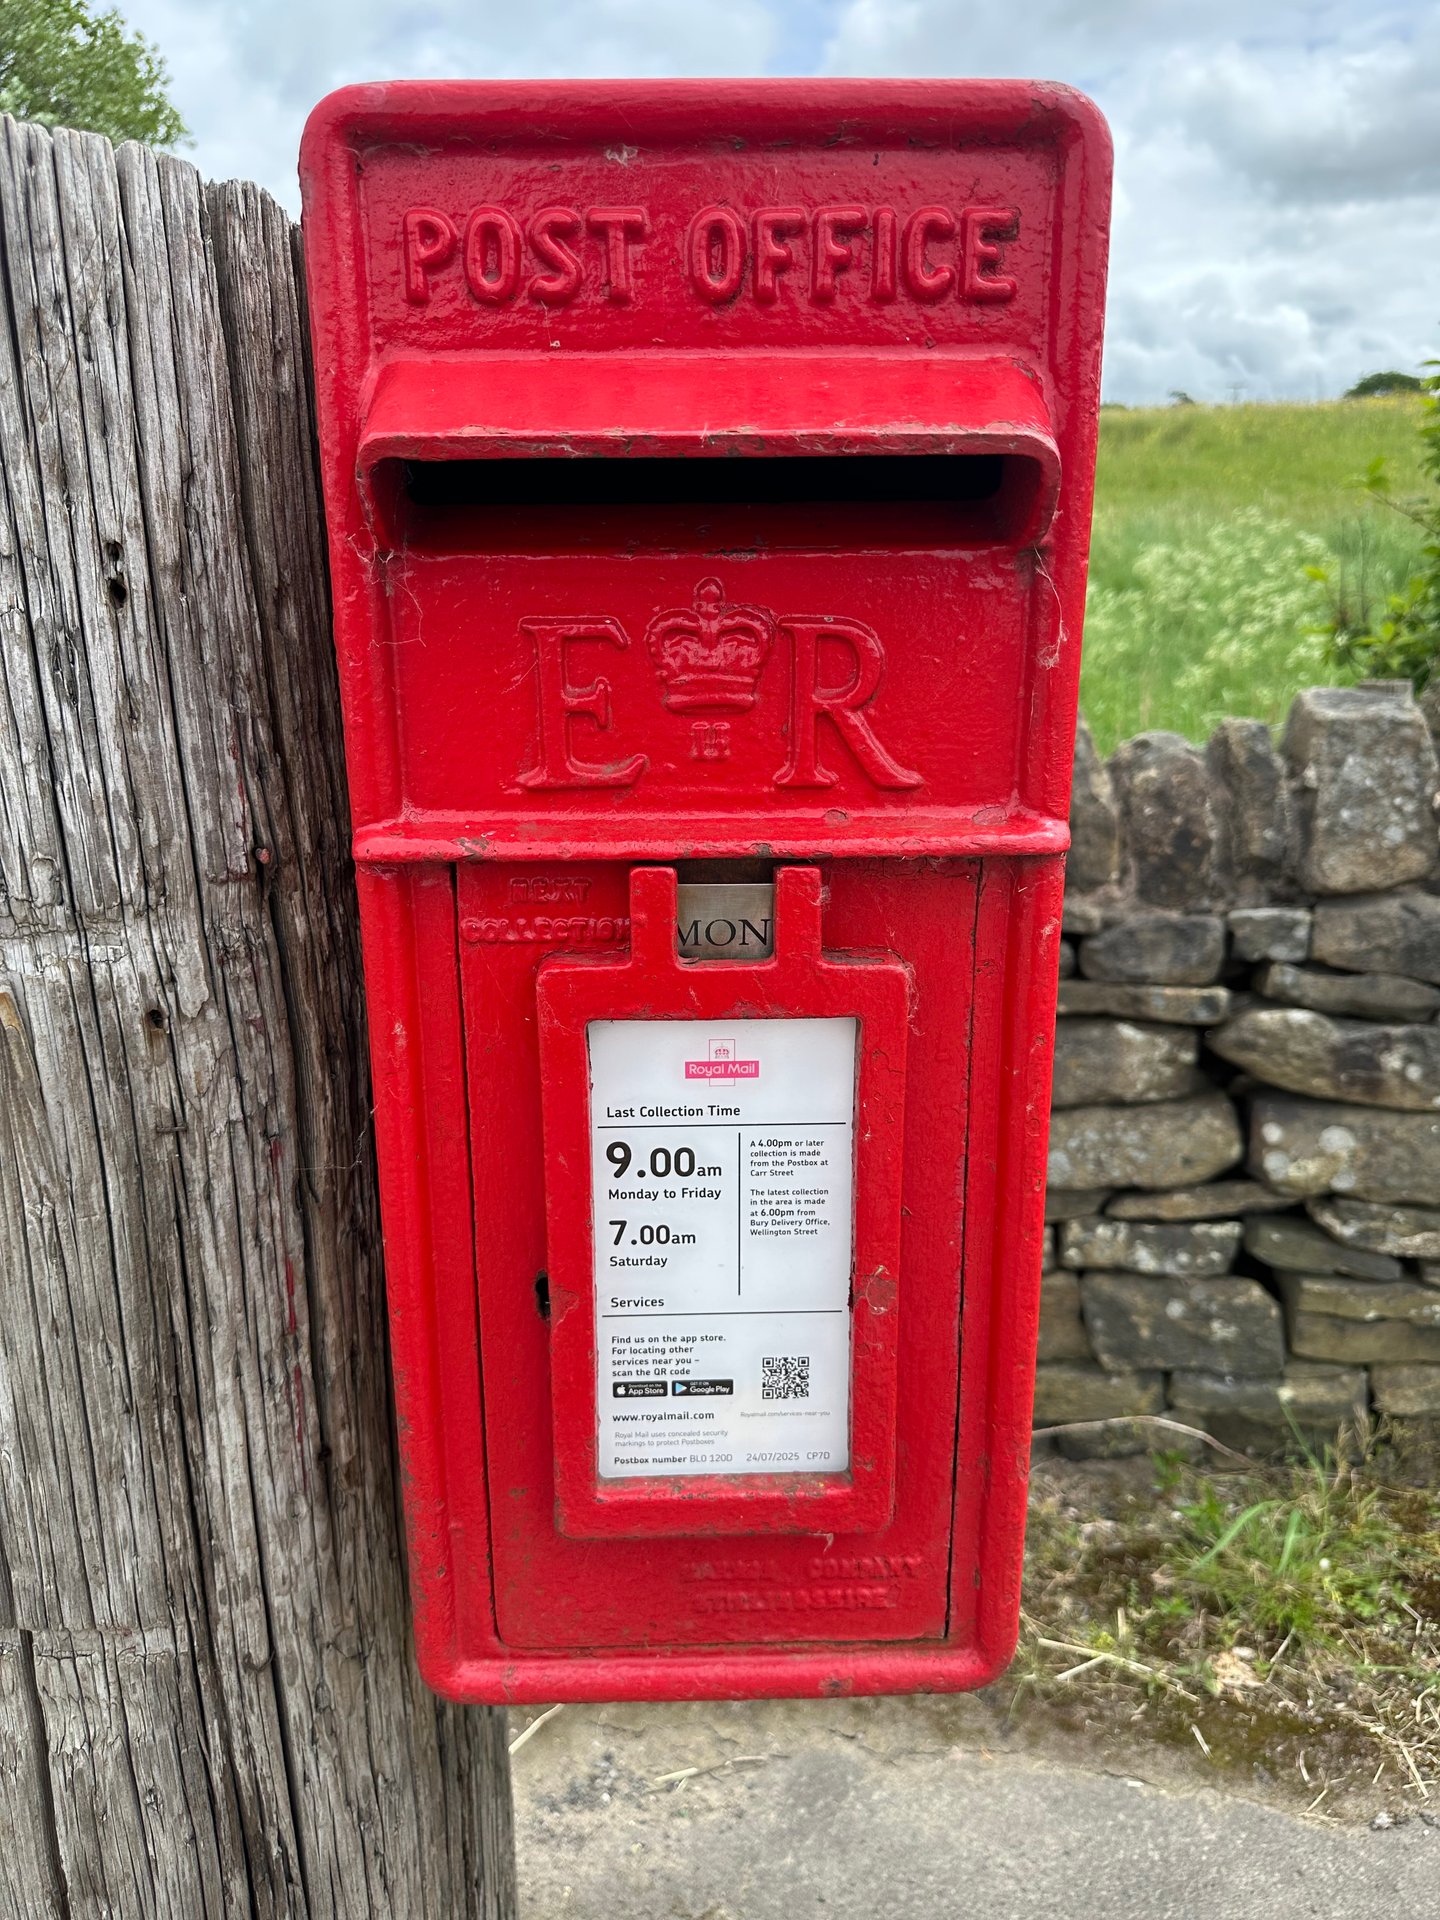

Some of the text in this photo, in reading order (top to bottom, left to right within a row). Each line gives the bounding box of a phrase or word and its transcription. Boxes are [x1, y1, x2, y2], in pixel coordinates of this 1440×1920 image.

[403, 206, 1019, 304] POST OFFICE
[515, 614, 928, 790] E R
[677, 918, 771, 947] MON
[689, 1063, 755, 1077] Royal Mail
[607, 1105, 740, 1118] Last Collection Time
[758, 1139, 792, 1148] 4.00pm
[751, 1150, 787, 1158] collection
[609, 1187, 721, 1201] Monday to Friday
[792, 1188, 828, 1196] collection
[761, 1209, 794, 1218] 6.00pm
[751, 1220, 768, 1228] Bury
[772, 1219, 802, 1228] Delivery
[750, 1228, 817, 1237] Wellington Street
[610, 1256, 667, 1267] Saturday
[611, 1297, 664, 1307] Services
[612, 1336, 631, 1344] Find
[663, 1335, 677, 1343] the
[679, 1336, 697, 1345] app
[612, 1346, 693, 1355] For locating other
[612, 1358, 648, 1366] services
[675, 1358, 691, 1367] you
[636, 1369, 650, 1377] the
[654, 1368, 666, 1376] QR
[670, 1368, 690, 1376] code
[628, 1388, 644, 1396] App
[690, 1385, 730, 1394] Google Play
[613, 1412, 714, 1422] www.royalmail.com
[615, 1432, 633, 1441] Royal
[668, 1431, 700, 1439] concealed
[702, 1430, 728, 1439] security
[656, 1440, 679, 1448] protect
[614, 1457, 648, 1465] Postbox
[653, 1456, 686, 1464] number
[747, 1452, 799, 1462] 24/07/2025
